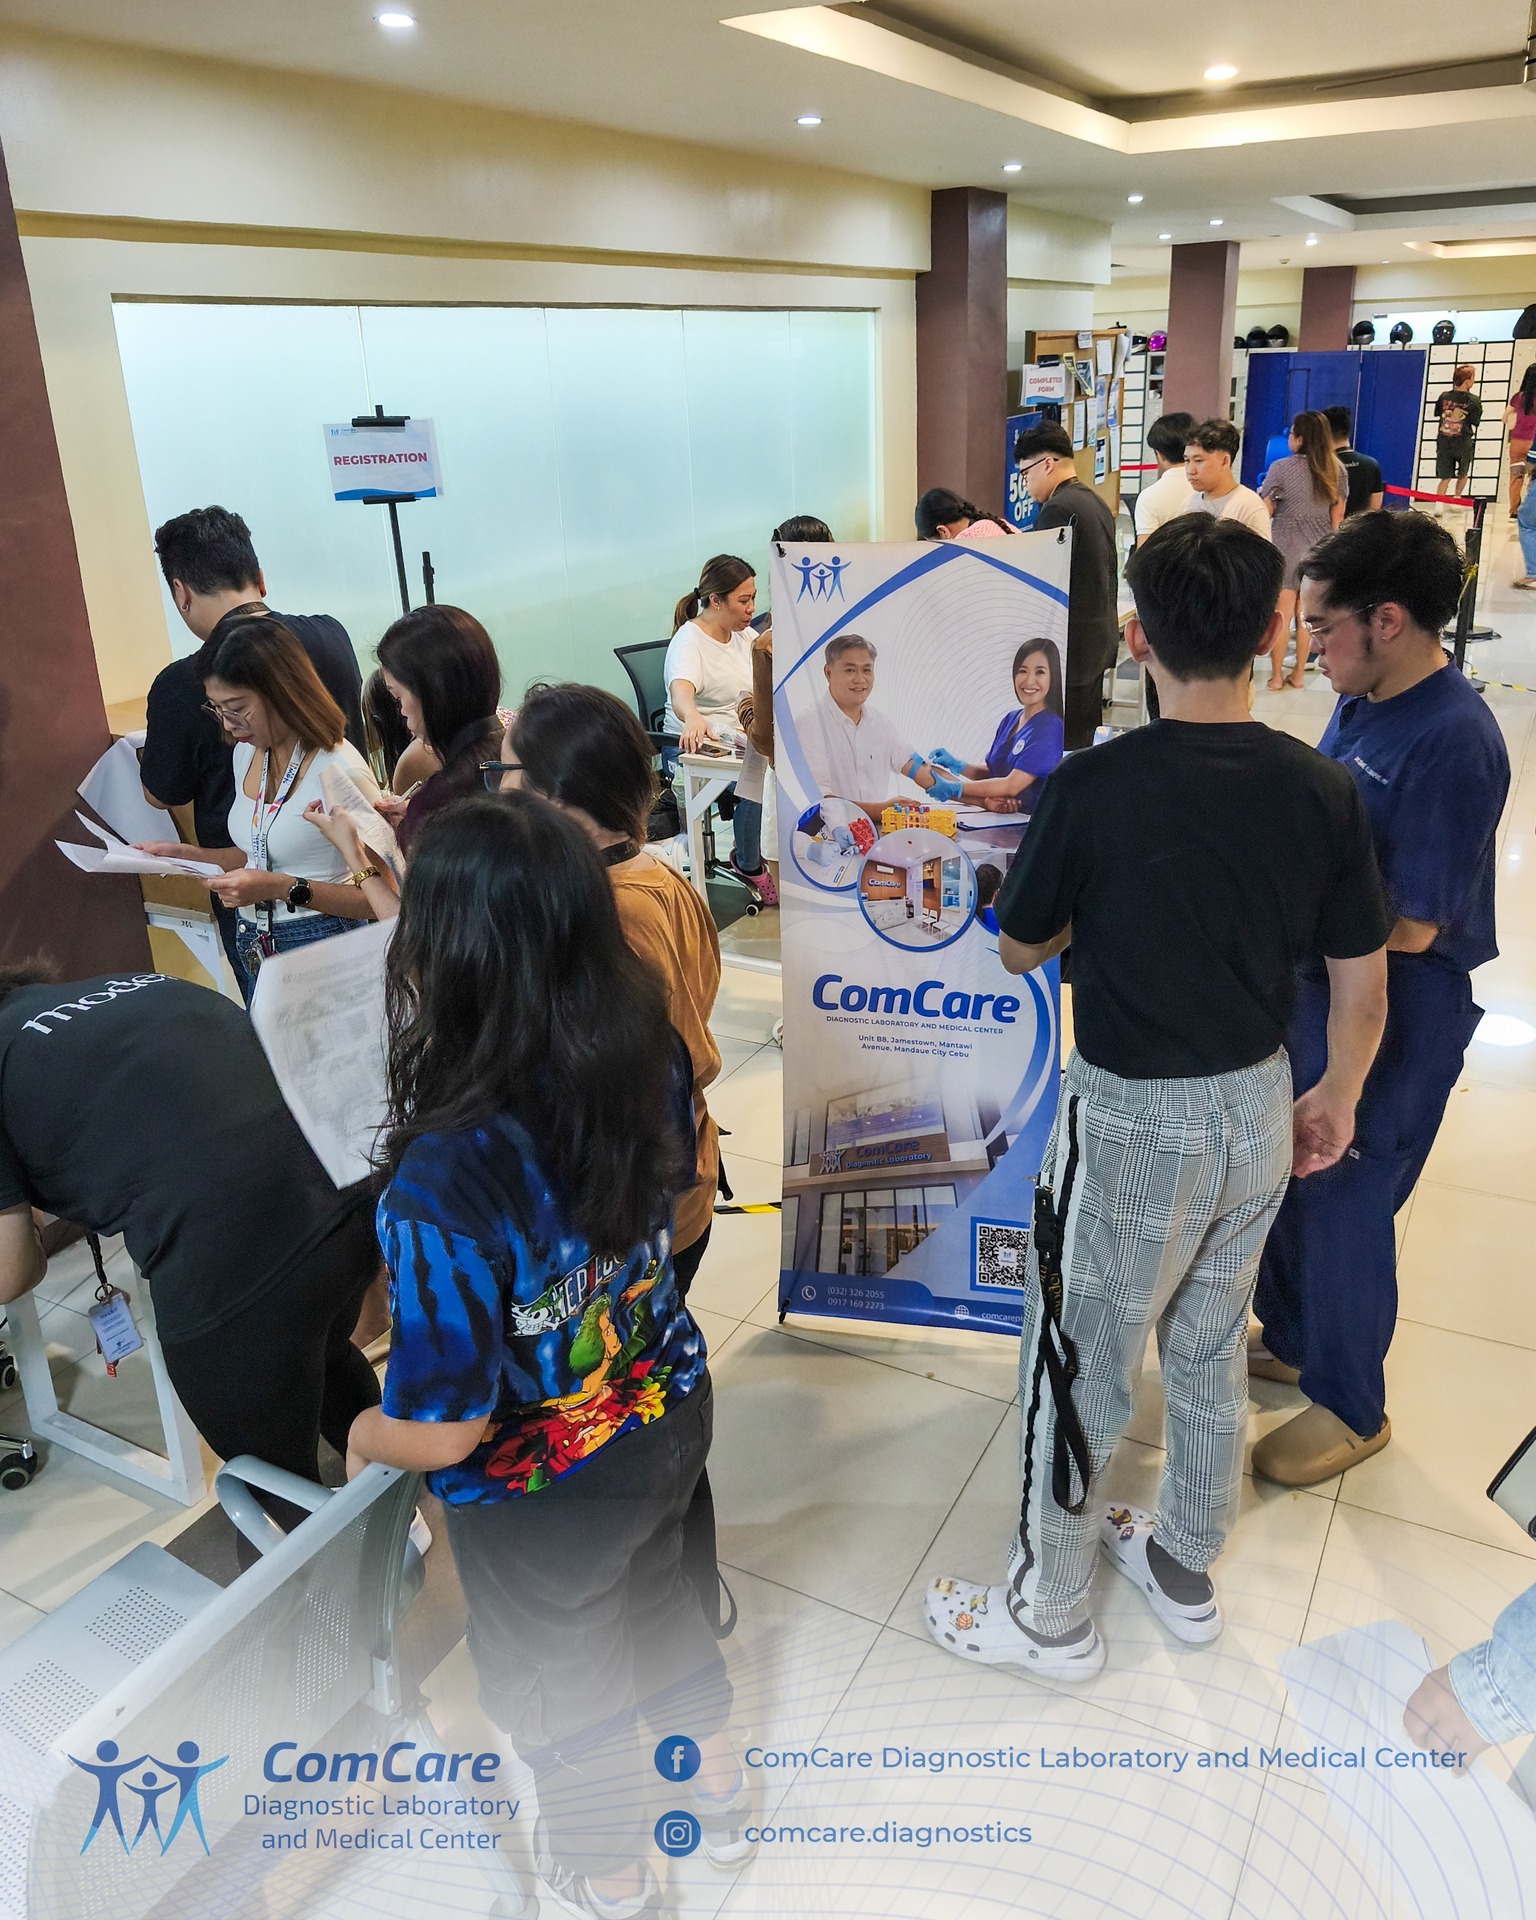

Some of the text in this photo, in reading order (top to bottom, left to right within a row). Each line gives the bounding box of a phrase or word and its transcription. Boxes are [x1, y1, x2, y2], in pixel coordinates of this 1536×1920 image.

[1029, 377, 1063, 385] COMPLETED
[333, 452, 428, 466] REGISTRATION
[1014, 497, 1034, 521] OFF
[812, 974, 1021, 1024] ComCare
[826, 1015, 1004, 1035] DIAGNOSTIC LABORATORY AND MEDICAL CENTER
[861, 1043, 970, 1058] Avenue, Mandaue City Cebu
[890, 1037, 938, 1048] Jamestown,
[938, 1041, 973, 1050] Mantawi
[855, 1139, 920, 1159] ComCare
[845, 1152, 933, 1169] Diagnostic Laboratory
[827, 1286, 885, 1300] (032) 326 2055
[827, 1297, 885, 1311] 0917 169 2273
